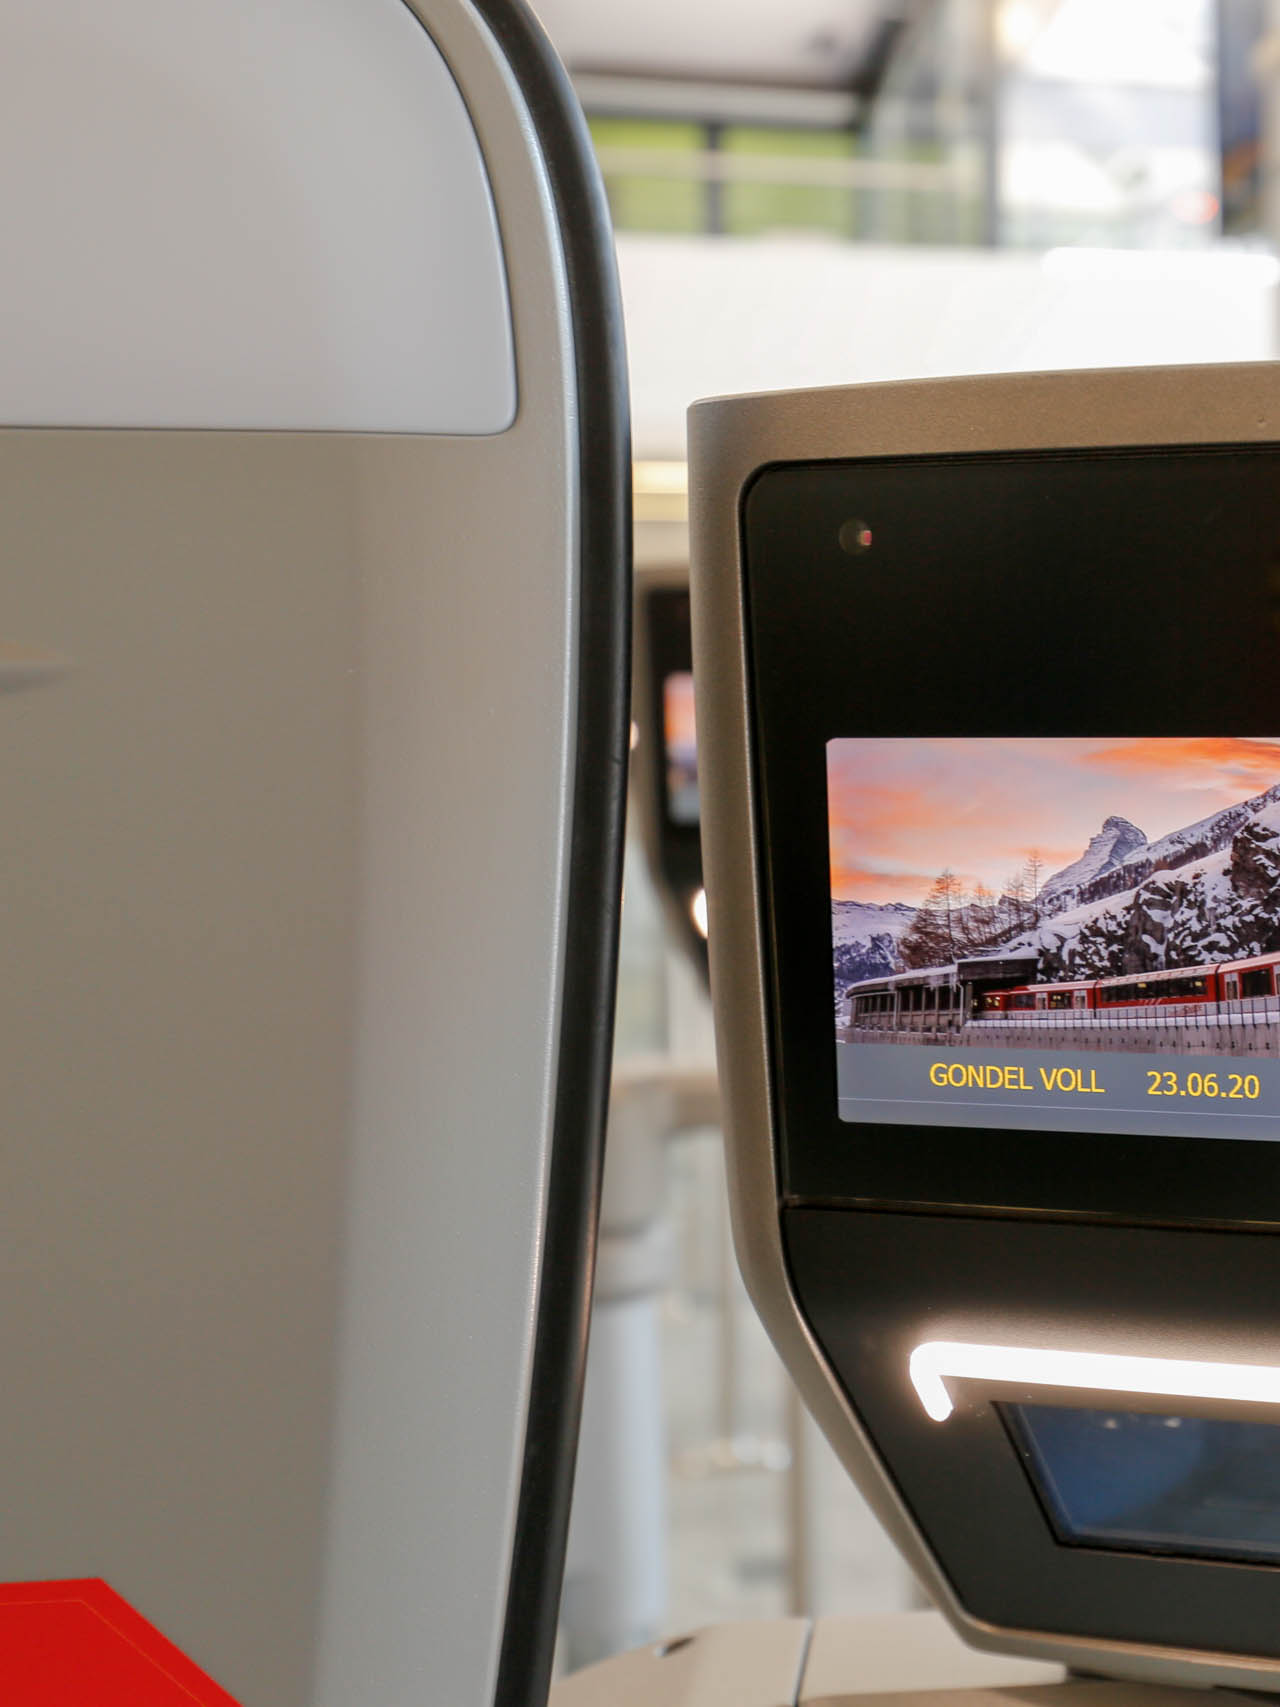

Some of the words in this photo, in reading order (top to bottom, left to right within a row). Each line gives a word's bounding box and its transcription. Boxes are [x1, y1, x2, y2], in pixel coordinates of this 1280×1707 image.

[929, 1062, 1034, 1091] GONDEL
[1039, 1067, 1105, 1094] VOLL
[1146, 1070, 1261, 1100] 23.06.20
